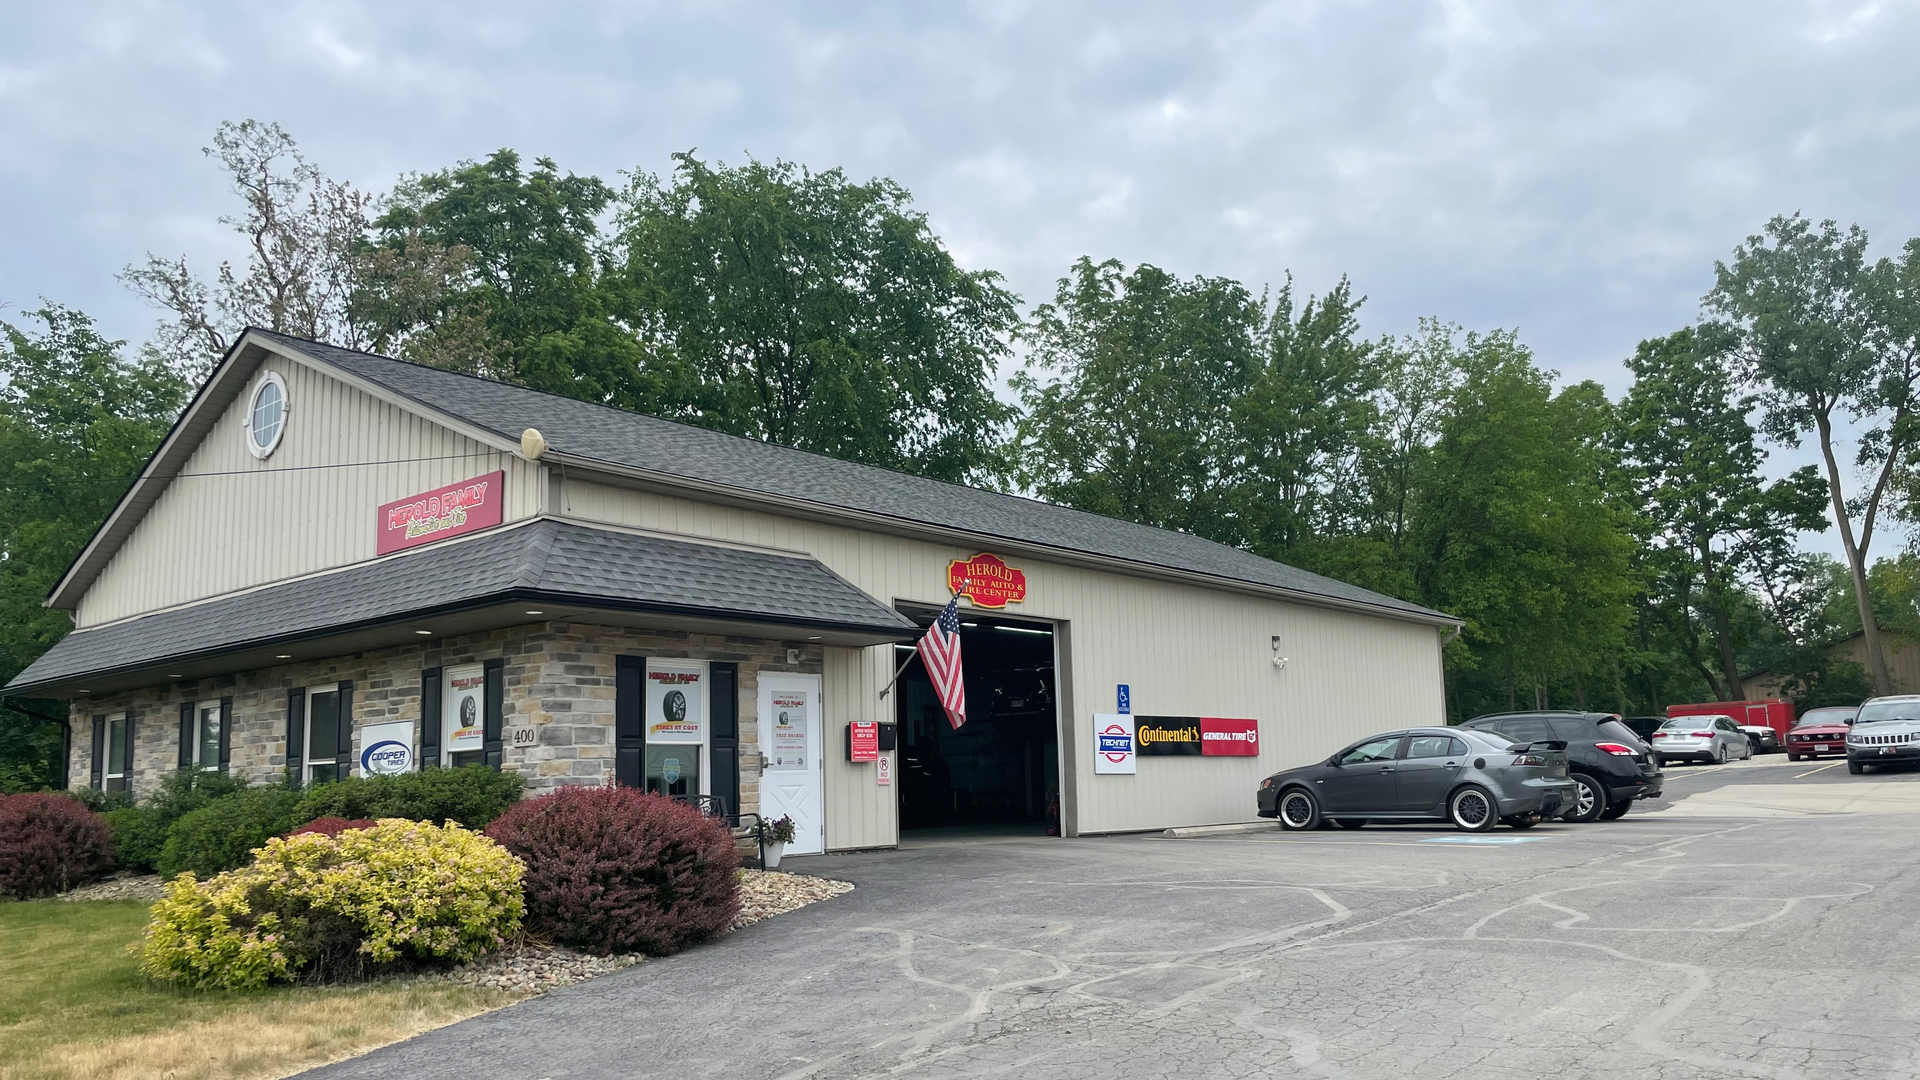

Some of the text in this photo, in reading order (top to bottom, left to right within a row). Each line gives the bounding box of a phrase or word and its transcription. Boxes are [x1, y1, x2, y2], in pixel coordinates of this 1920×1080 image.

[388, 482, 488, 530] HEROLD FAMILY
[966, 563, 1013, 582] HEROLD
[990, 580, 1015, 590] AUTO
[983, 588, 1019, 598] CENTER
[514, 729, 535, 744] 400
[1138, 724, 1192, 747] Continental
[1203, 731, 1231, 741] GENERAL
[1231, 732, 1247, 741] TIRE
[371, 750, 406, 761] COOPER
